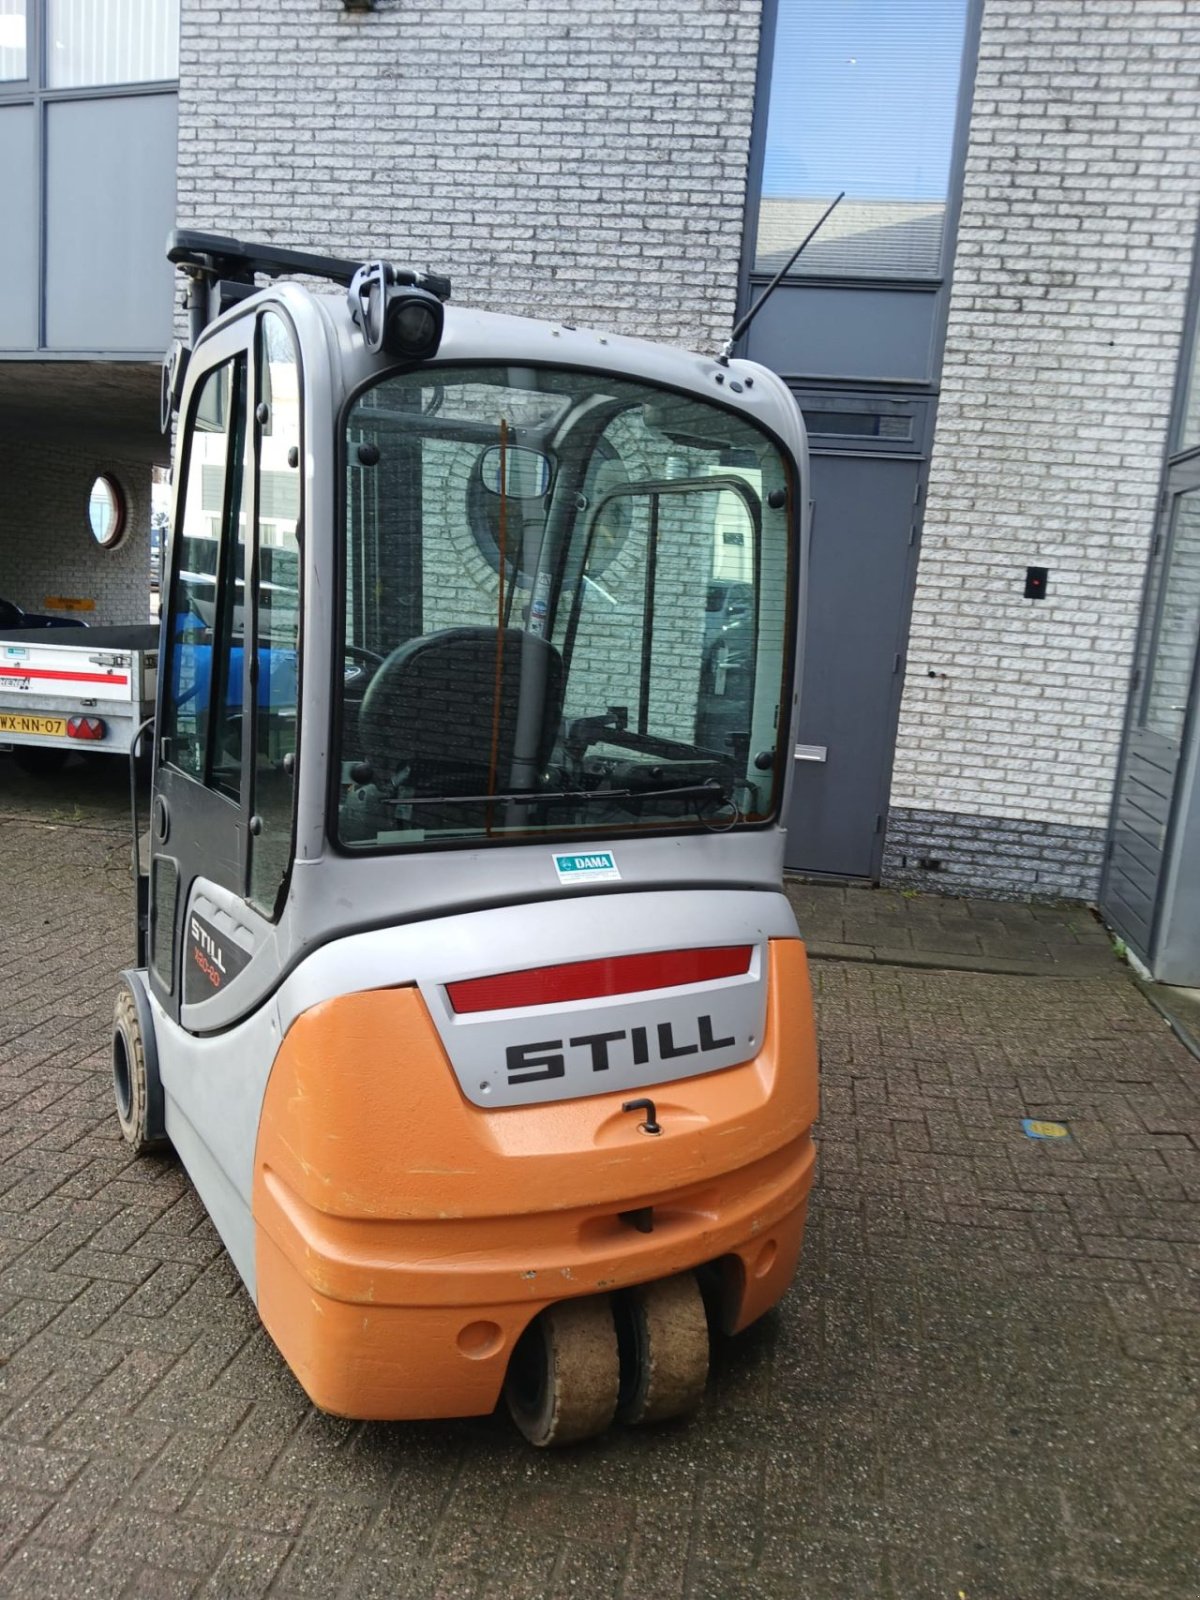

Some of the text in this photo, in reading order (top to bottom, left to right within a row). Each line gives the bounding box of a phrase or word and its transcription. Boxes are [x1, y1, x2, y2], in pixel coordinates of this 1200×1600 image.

[0, 716, 62, 733] WX-NN-07
[575, 857, 611, 869] DAMA
[191, 917, 227, 974] STILL
[505, 1015, 736, 1085] STILL
